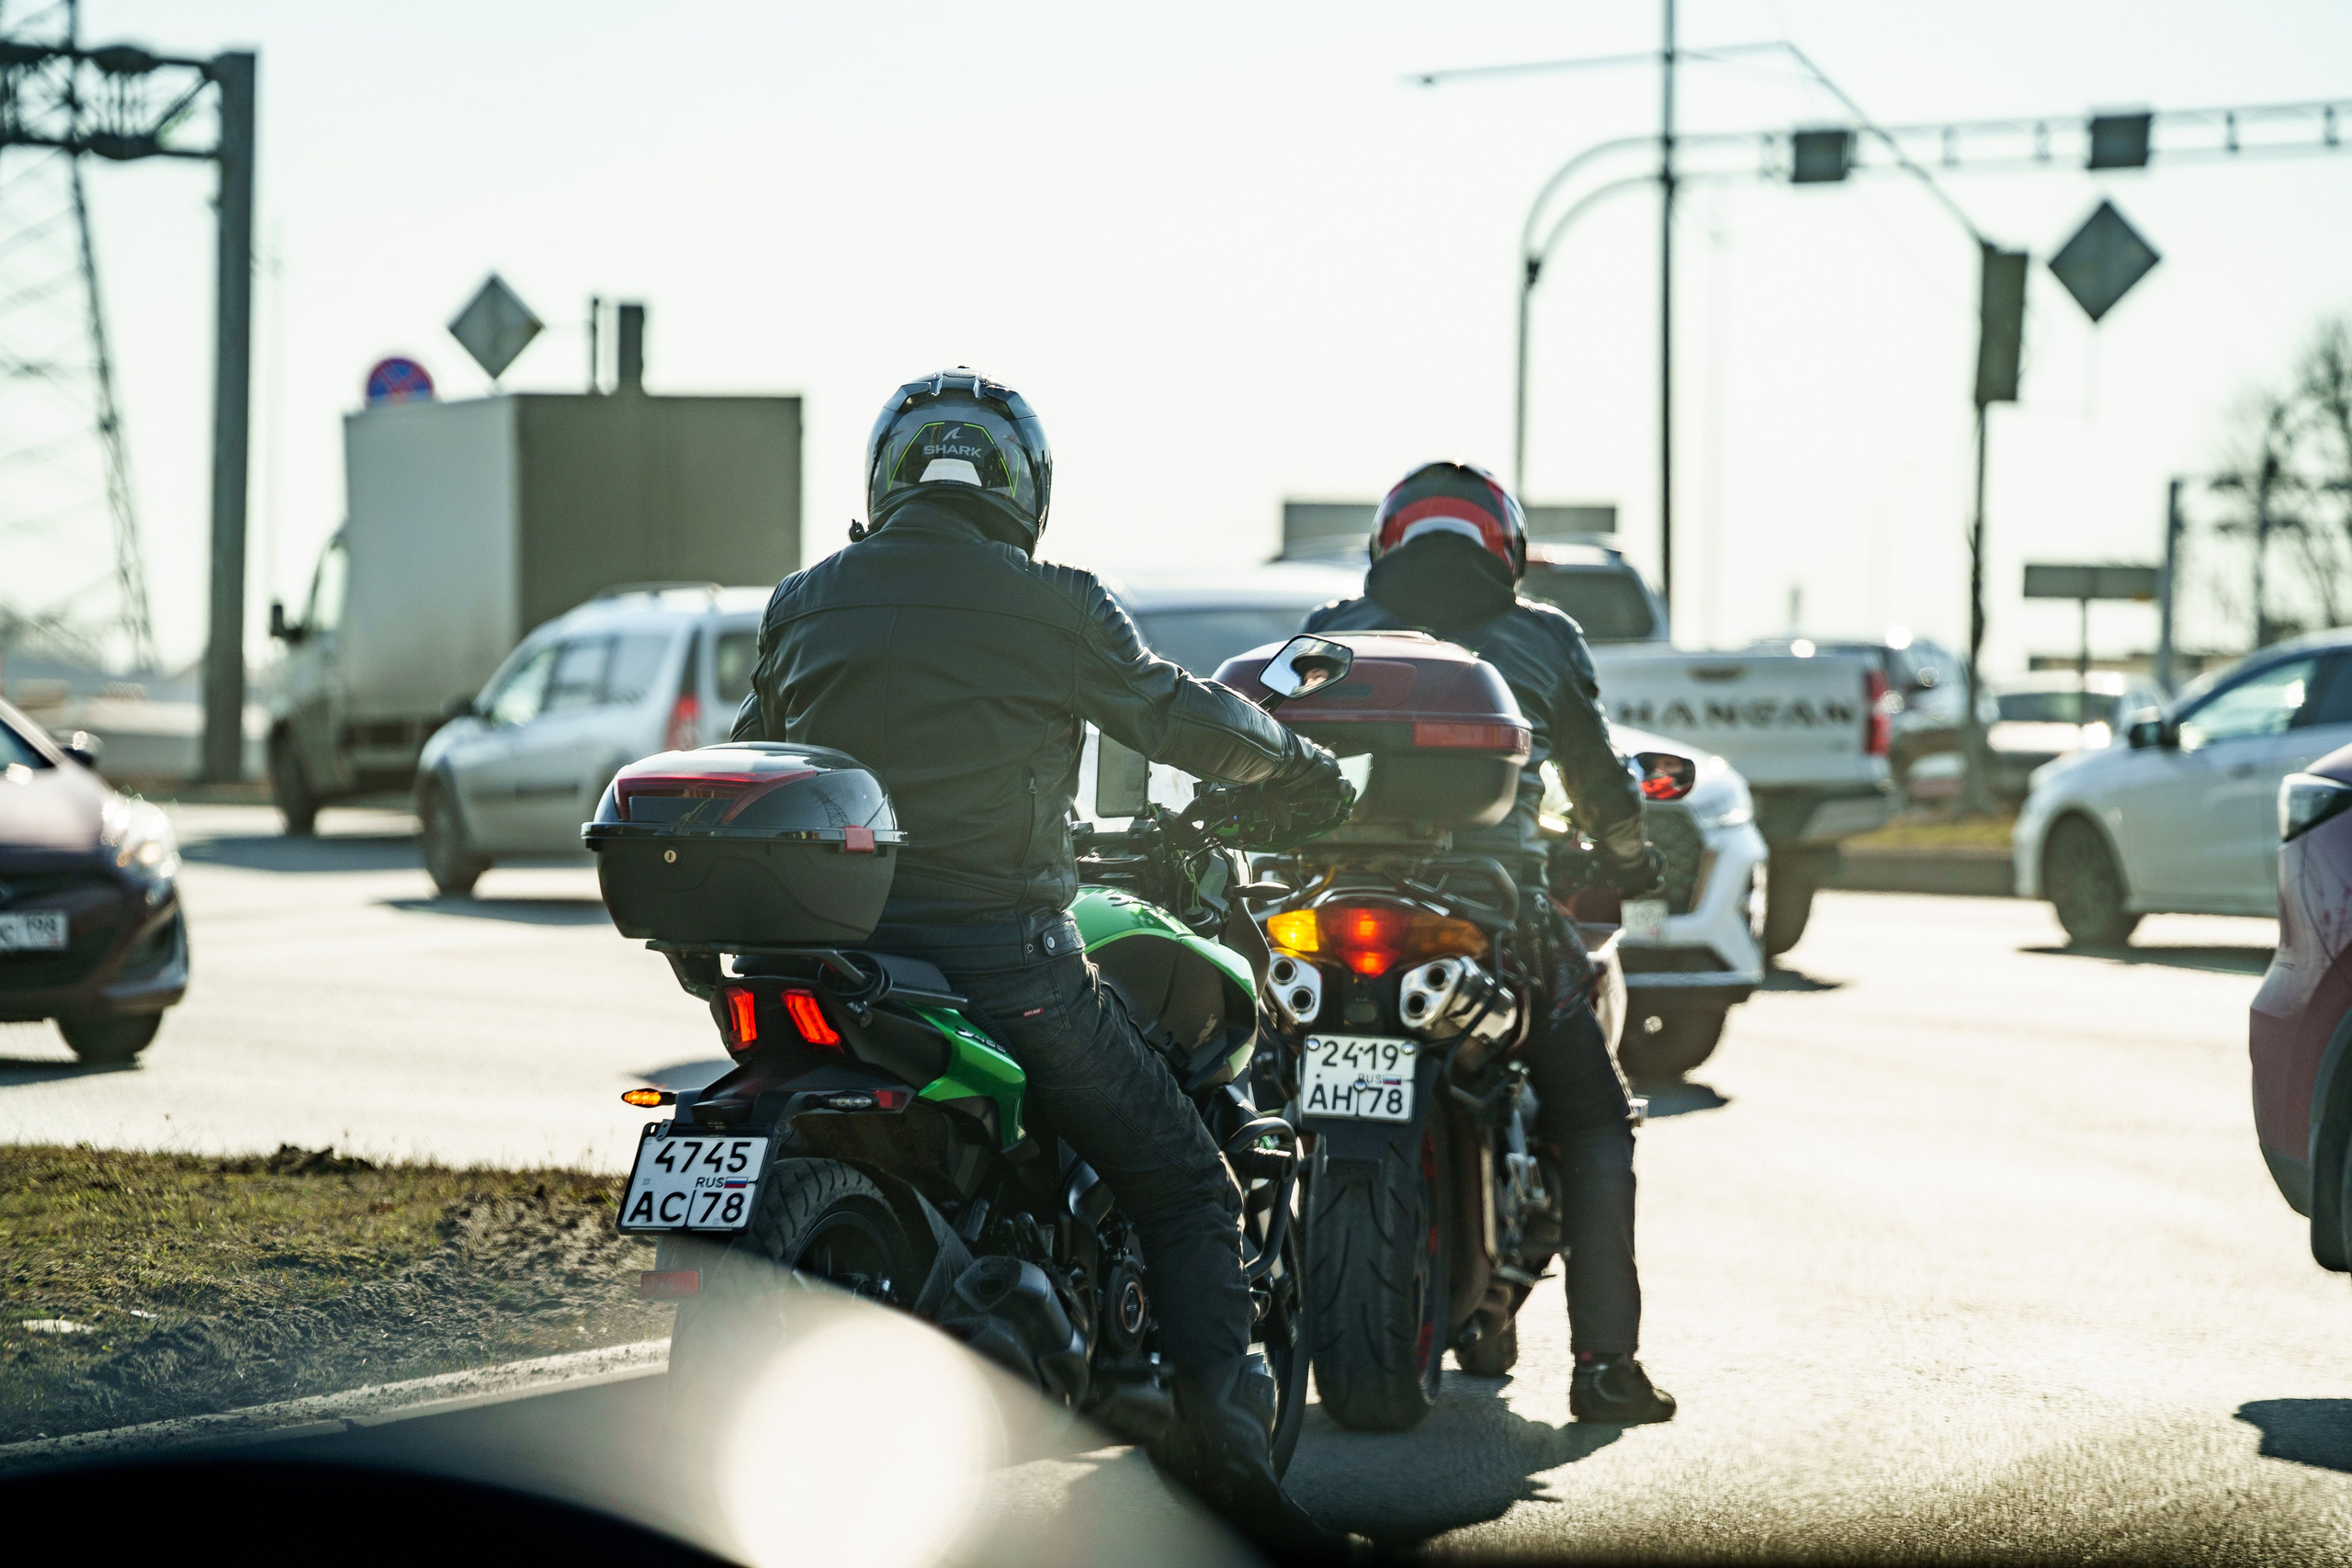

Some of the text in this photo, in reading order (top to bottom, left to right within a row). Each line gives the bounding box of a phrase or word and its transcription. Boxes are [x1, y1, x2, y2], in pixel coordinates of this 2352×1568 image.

[923, 444, 982, 457] SHARK
[1617, 697, 1854, 728] HANGAN
[1321, 1040, 1398, 1070] 2419
[1307, 1083, 1403, 1114] AH 78
[655, 1141, 752, 1173] 4745
[695, 1177, 725, 1189] RUS
[628, 1190, 745, 1224] AC 78
